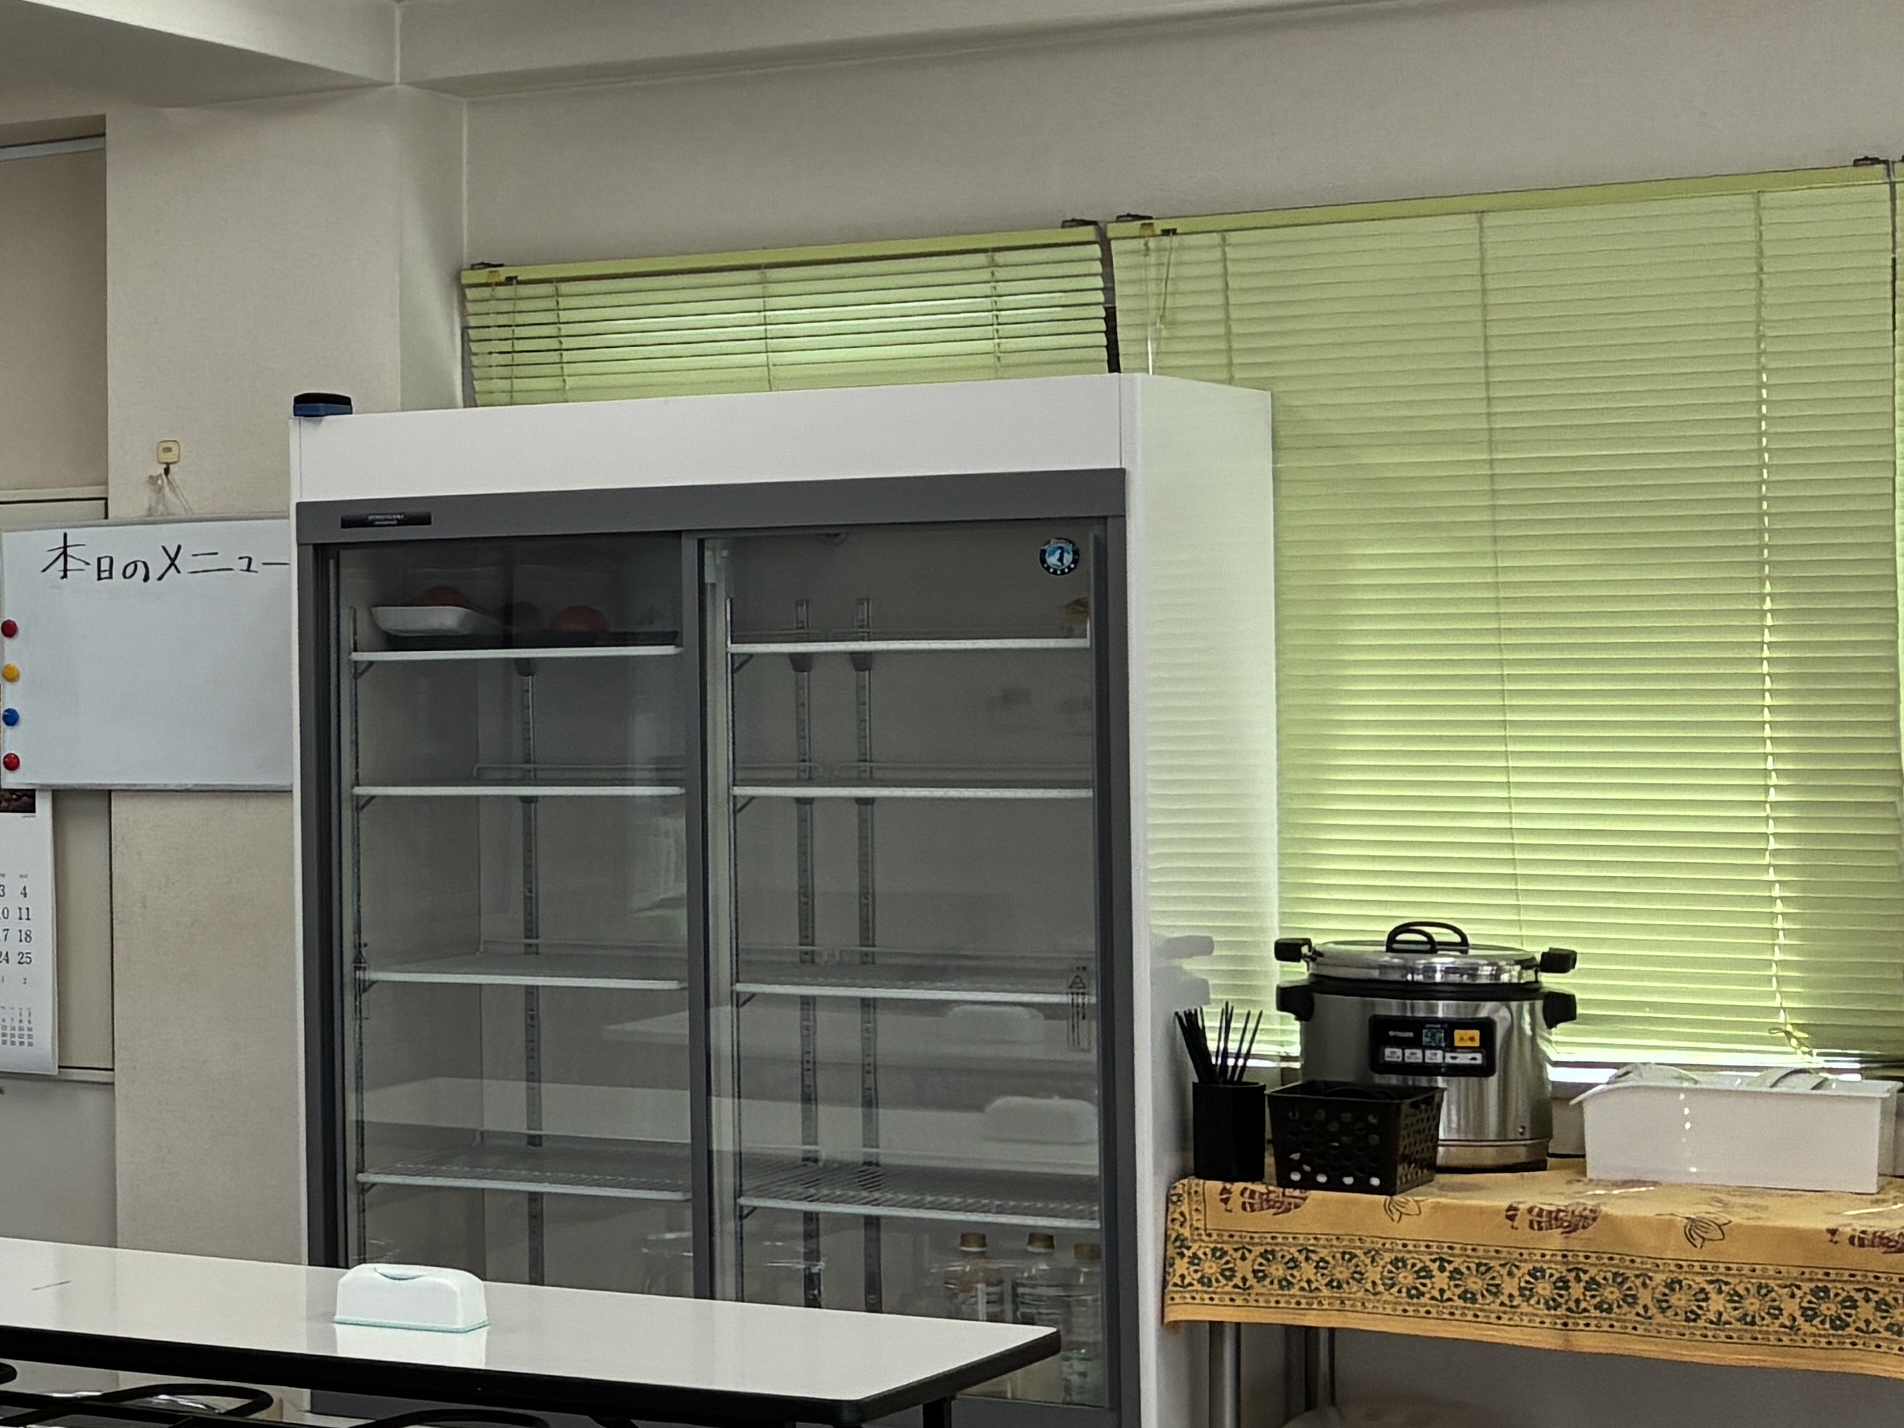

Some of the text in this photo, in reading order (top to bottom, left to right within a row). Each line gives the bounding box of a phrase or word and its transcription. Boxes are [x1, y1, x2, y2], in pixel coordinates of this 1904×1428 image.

[41, 532, 290, 583] 本日のメニュー
[20, 886, 27, 898] 4
[17, 907, 30, 920] 11
[18, 929, 32, 943] 18
[17, 952, 32, 964] 25
